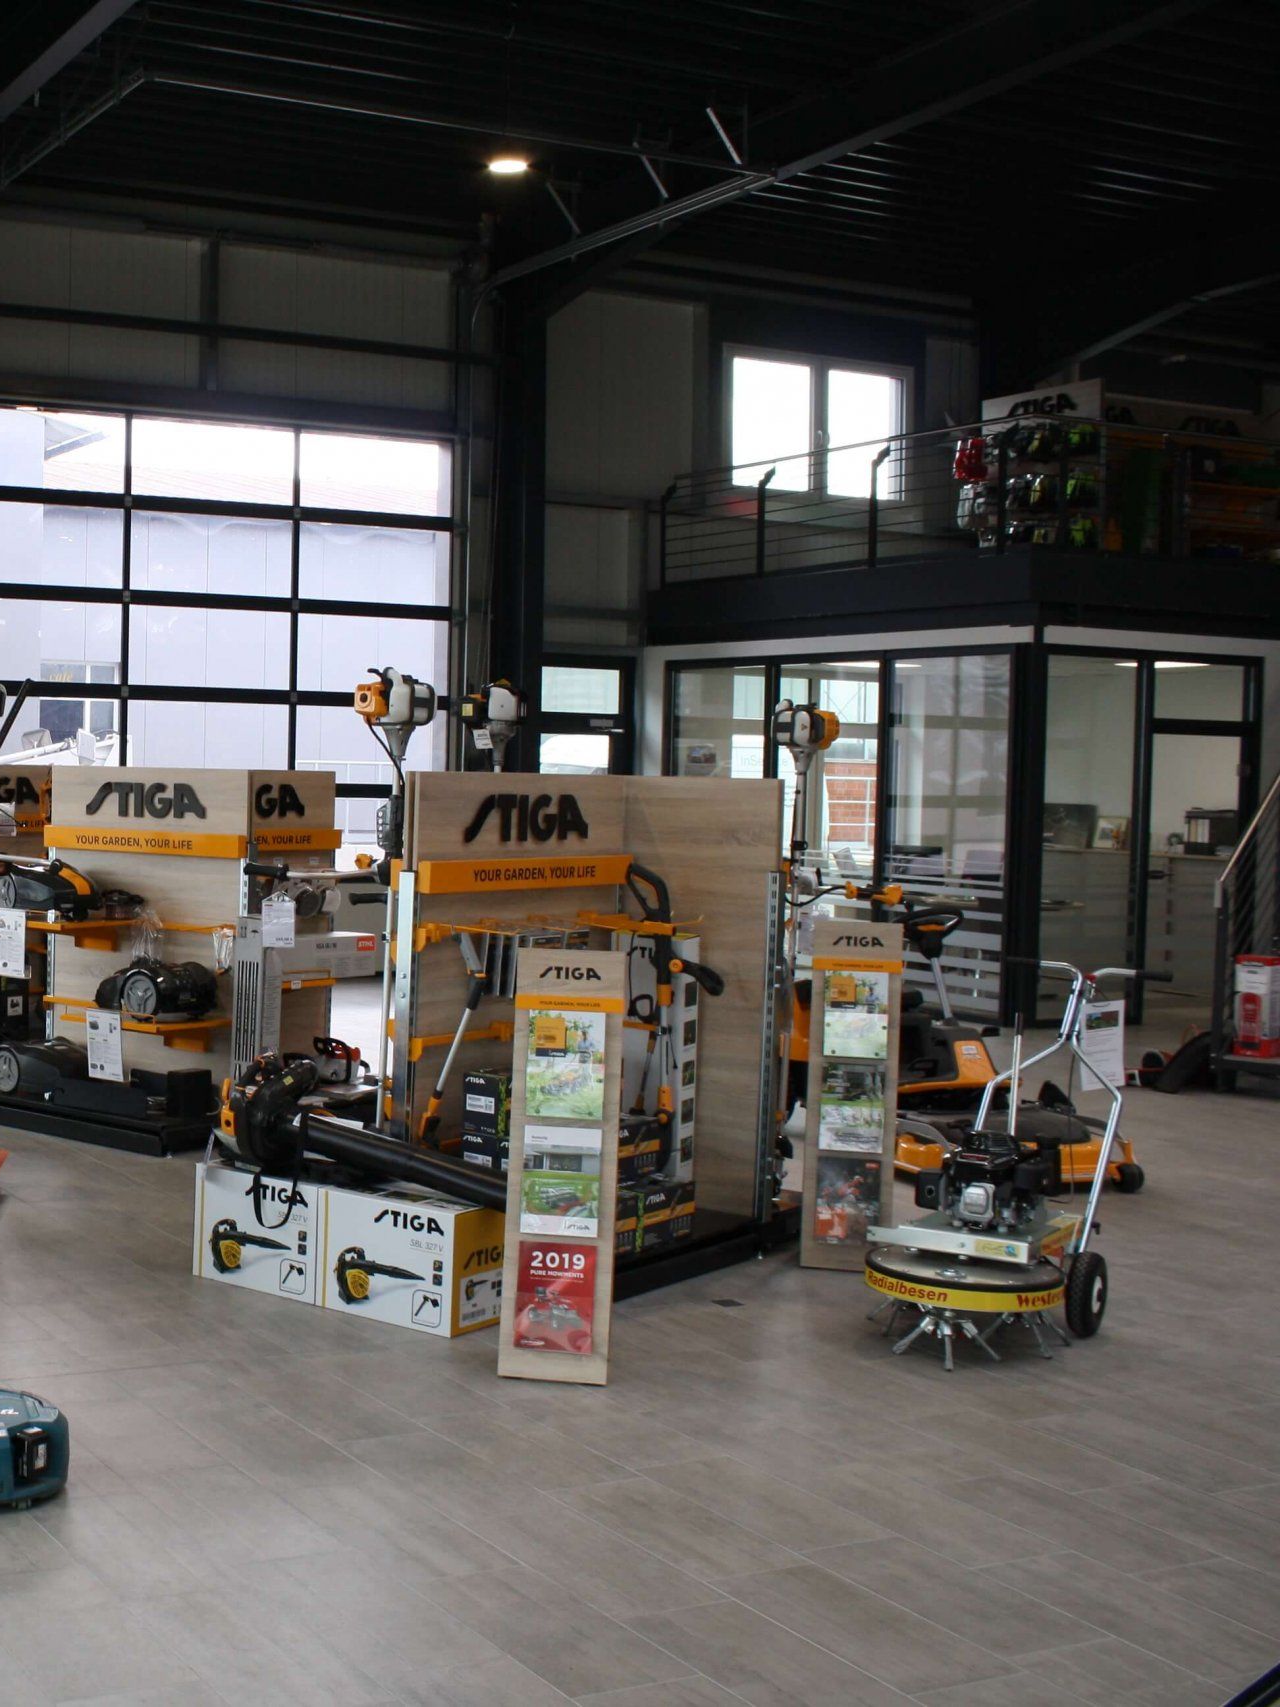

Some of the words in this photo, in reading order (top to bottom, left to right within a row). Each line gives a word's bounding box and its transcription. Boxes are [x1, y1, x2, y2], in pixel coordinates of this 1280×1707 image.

[1007, 393, 1077, 417] STIGA
[86, 782, 206, 819] STIGA
[464, 793, 589, 844] STIGA
[75, 834, 100, 846] YOUR
[101, 836, 142, 849] GARDEN,
[145, 838, 170, 849] YOUR
[172, 839, 193, 850] LIFE
[272, 835, 294, 845] YOUR
[295, 834, 312, 844] LIFE
[473, 867, 501, 882] YOUR
[503, 866, 547, 882] GARDEN,
[550, 865, 575, 880] YOUR
[577, 864, 596, 879] LIFE
[832, 936, 884, 948] STIGA
[627, 945, 656, 959] STI
[539, 966, 602, 981] STIGA
[465, 1076, 486, 1084] STIGA
[463, 1135, 483, 1143] STIGA
[245, 1182, 308, 1208] STIGA
[646, 1193, 666, 1205] STIGA
[374, 1209, 445, 1237] STIGA
[425, 1241, 437, 1251] 327
[463, 1245, 504, 1270] STIG
[531, 1251, 585, 1270] 2019
[868, 1270, 949, 1303] Radialbesen
